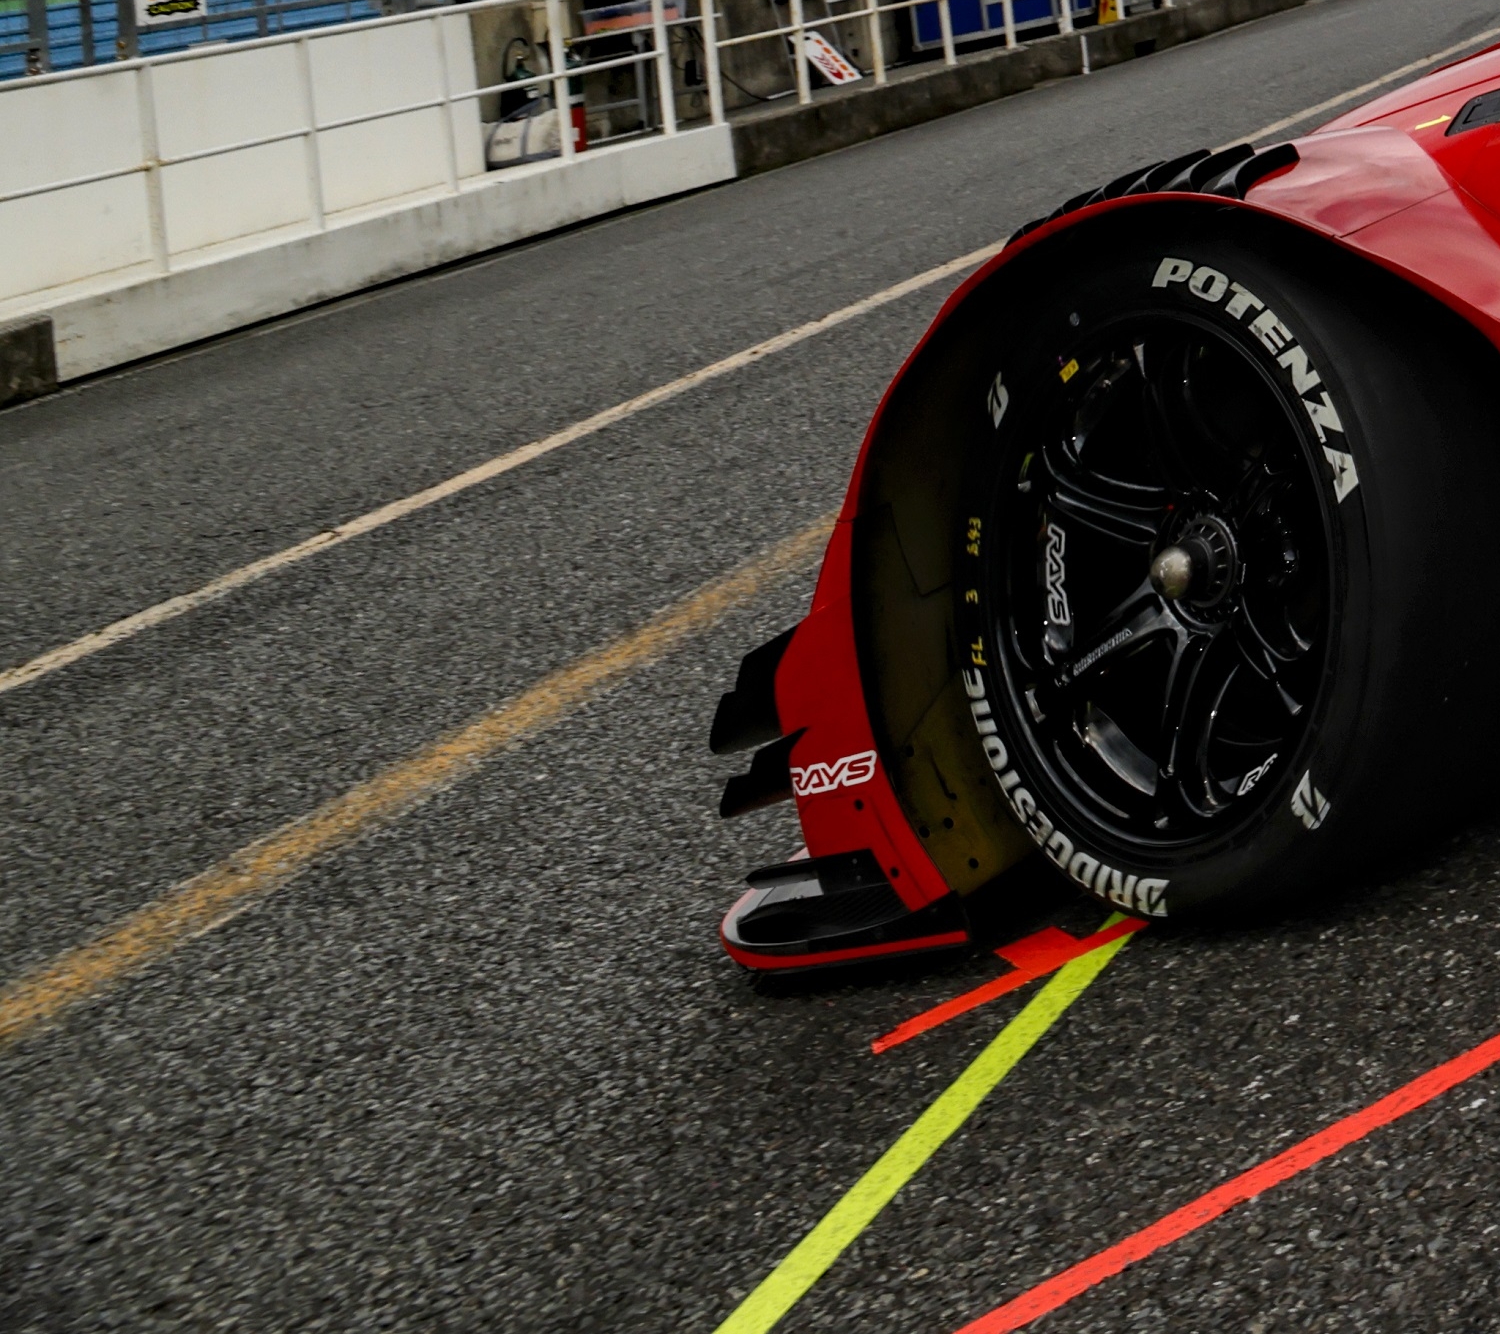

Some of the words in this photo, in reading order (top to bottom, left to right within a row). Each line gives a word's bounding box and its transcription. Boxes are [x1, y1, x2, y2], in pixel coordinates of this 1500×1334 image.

[1152, 257, 1360, 503] POTENZA
[1045, 521, 1073, 626] RAYS
[790, 749, 878, 797] RAYS
[964, 669, 1169, 917] BRIDGESTONE
